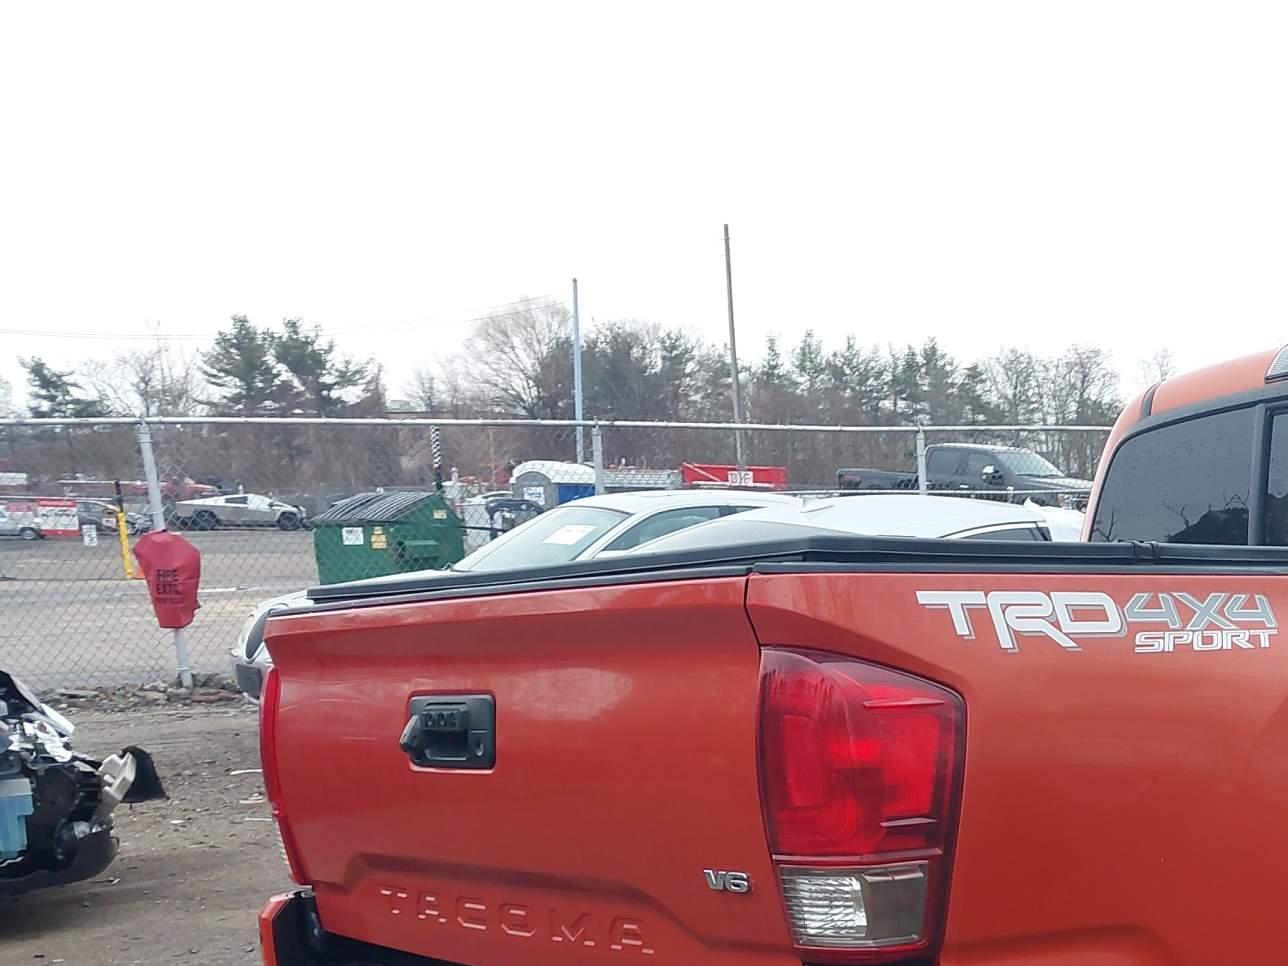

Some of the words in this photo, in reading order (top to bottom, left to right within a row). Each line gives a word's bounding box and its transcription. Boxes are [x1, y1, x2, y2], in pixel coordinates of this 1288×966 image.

[156, 569, 179, 582] FIRE
[915, 591, 1128, 653] TRD
[1134, 629, 1279, 653] SPORT
[703, 867, 751, 894] V6
[379, 884, 655, 955] TACOMA
